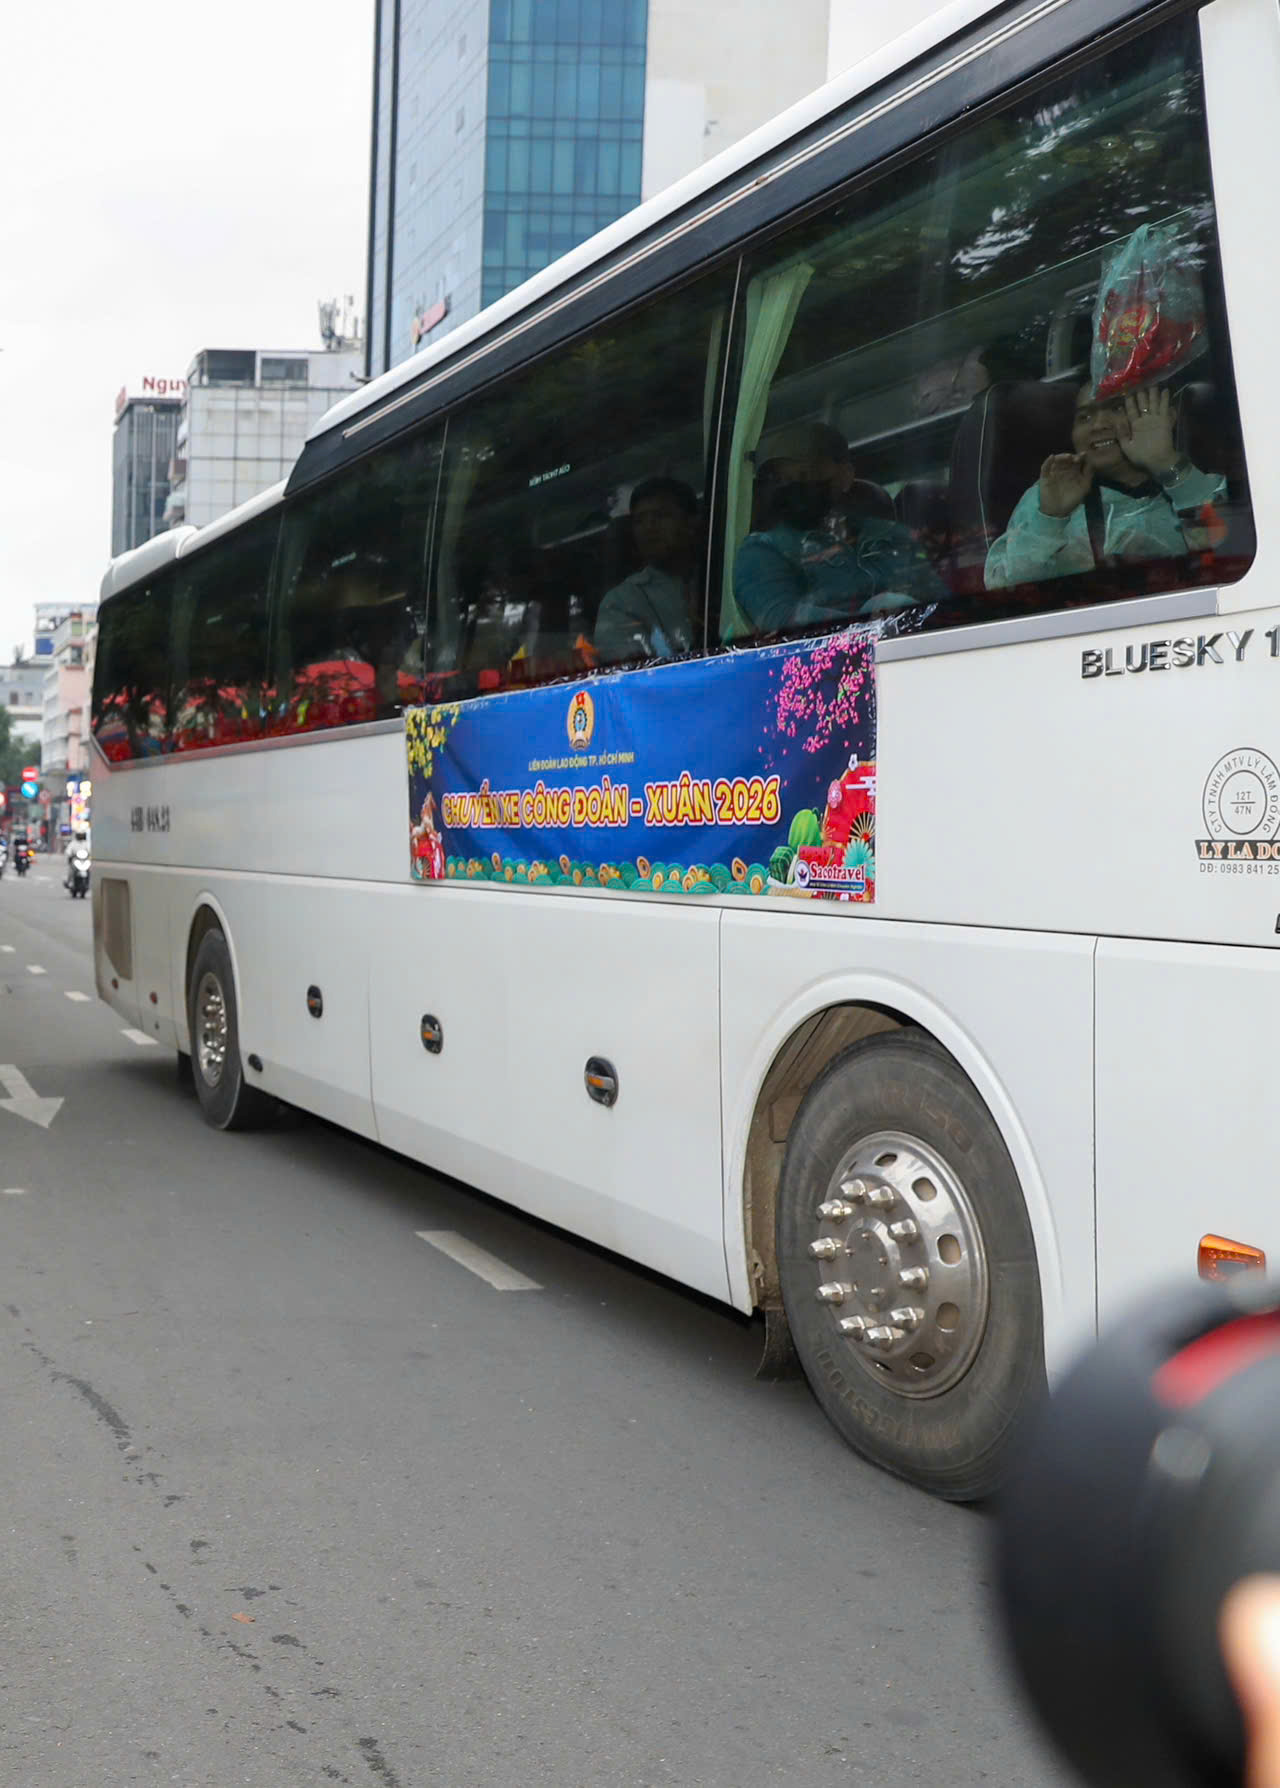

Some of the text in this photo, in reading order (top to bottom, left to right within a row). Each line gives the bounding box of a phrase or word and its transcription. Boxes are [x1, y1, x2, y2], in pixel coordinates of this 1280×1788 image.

[1081, 629, 1254, 679] BLUESKY
[1224, 756, 1244, 773] MTV
[1208, 771, 1225, 805] TNHH
[1236, 791, 1252, 801] 12T
[497, 790, 520, 828] XE
[521, 780, 570, 828] CÔNG
[570, 775, 629, 828] ĐOÀN
[644, 770, 715, 827] XUÂN
[715, 774, 781, 826] 2026
[1234, 805, 1252, 815] 47N
[1208, 810, 1222, 834] CTY
[1200, 842, 1225, 859] LY
[1227, 842, 1254, 859] LA
[810, 862, 865, 881] Sacotravel
[1220, 864, 1244, 874] 0983
[1246, 864, 1264, 875] 841
